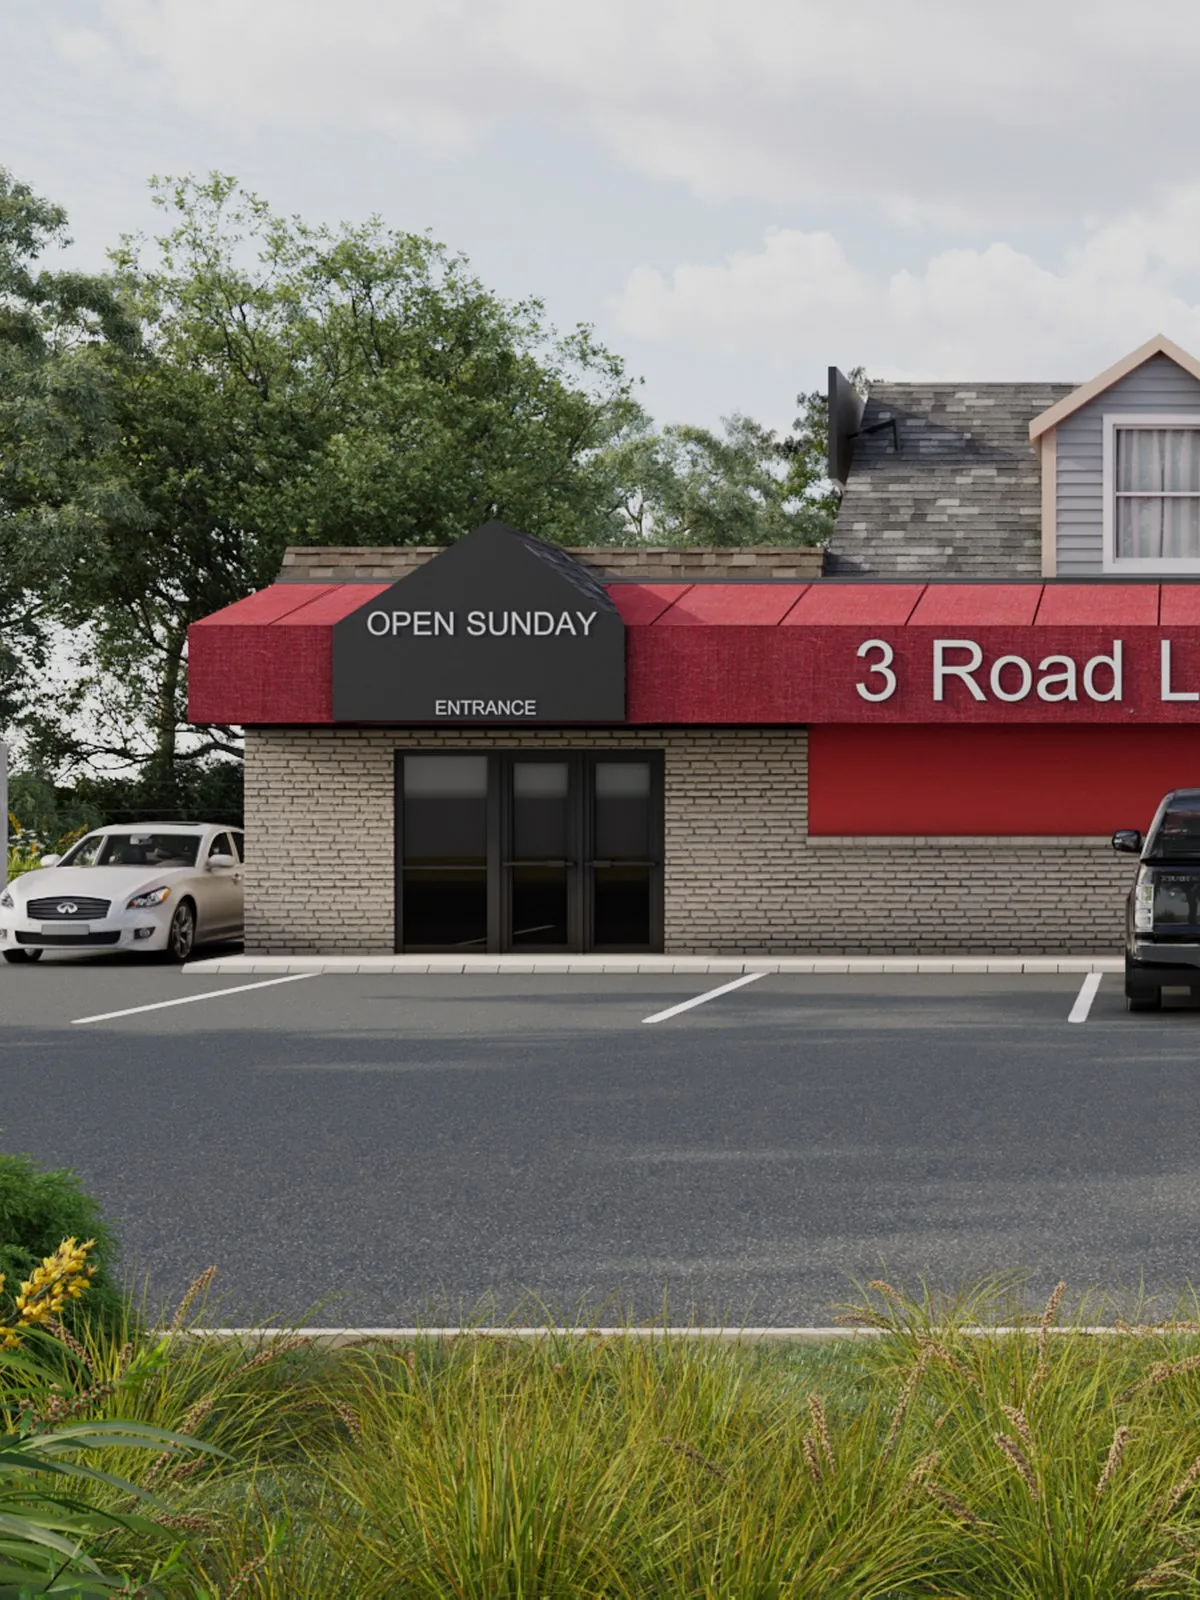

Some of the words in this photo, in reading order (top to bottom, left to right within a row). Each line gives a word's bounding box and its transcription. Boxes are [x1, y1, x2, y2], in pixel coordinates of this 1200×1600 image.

[366, 610, 455, 636] OPEN
[465, 610, 597, 636] SUNDAY
[855, 639, 897, 702] 3
[933, 639, 1122, 702] Road
[434, 699, 537, 716] ENTRANCE
